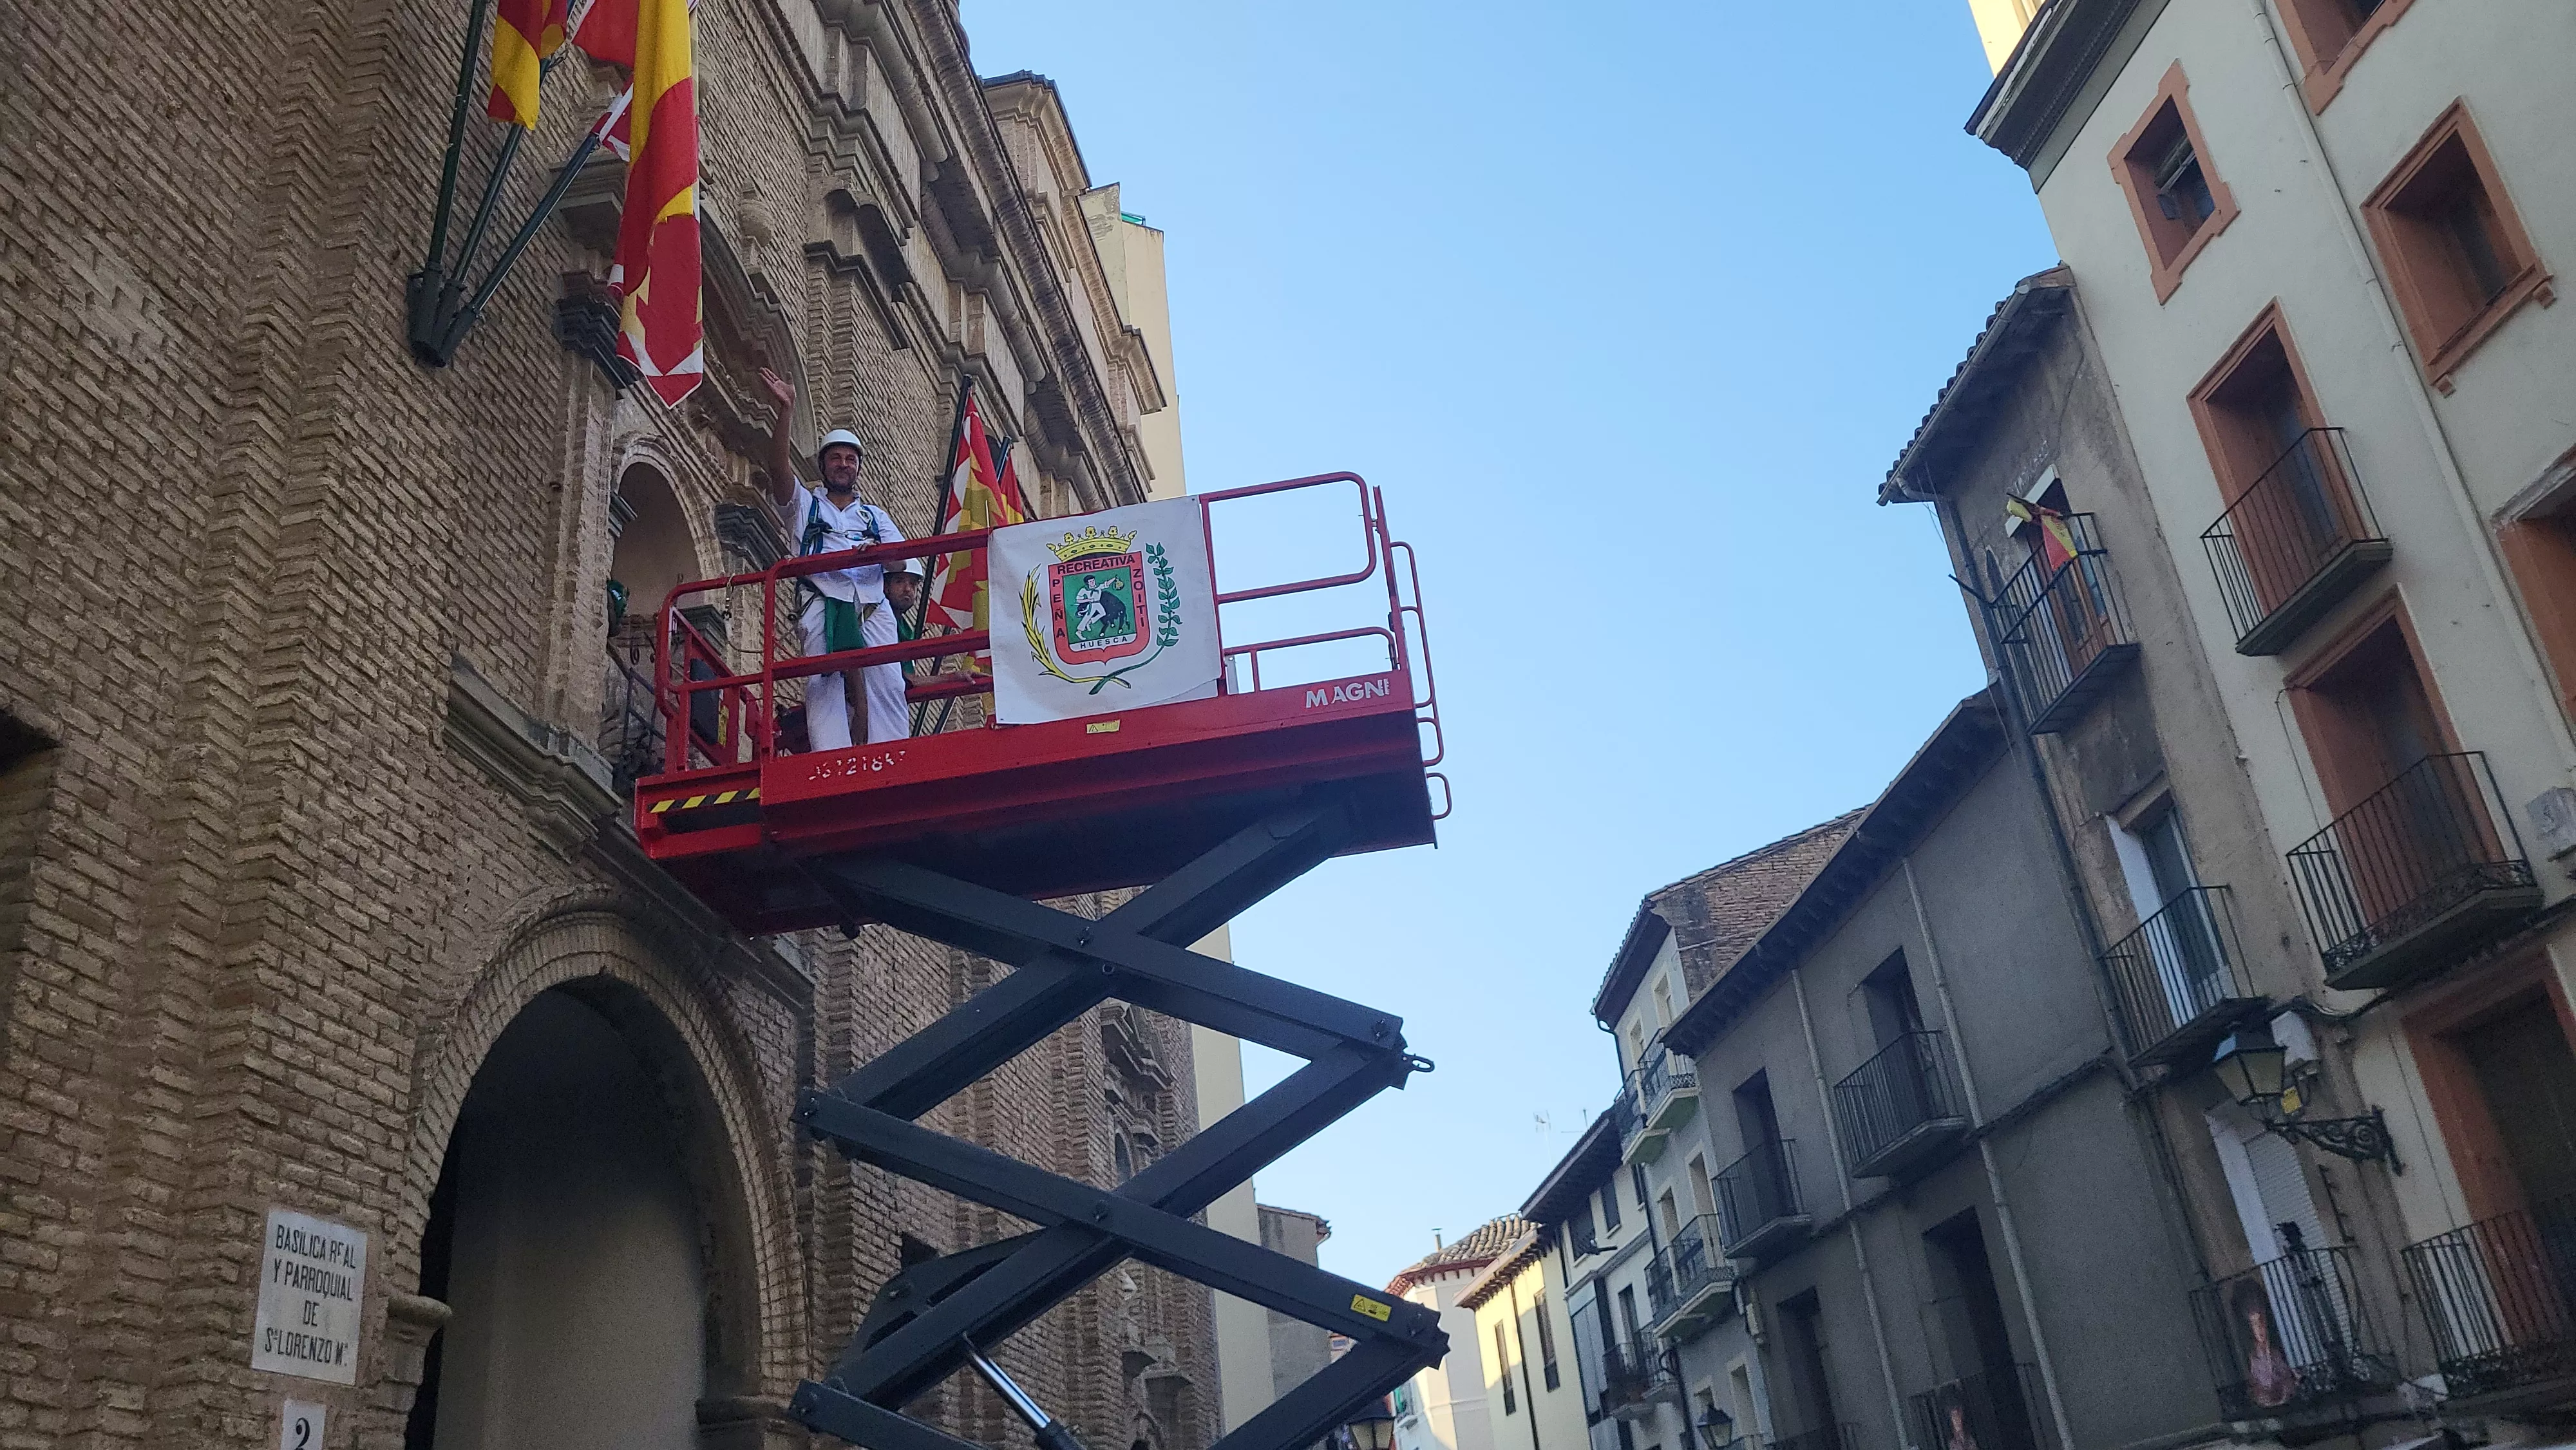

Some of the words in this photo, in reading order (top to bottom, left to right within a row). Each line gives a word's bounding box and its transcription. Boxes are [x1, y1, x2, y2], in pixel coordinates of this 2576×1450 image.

[1057, 554, 1135, 575] RECREATIVA
[1052, 579, 1066, 639] PEÑA
[1132, 568, 1146, 627] ZOITI
[1080, 636, 1128, 649] HUESCA
[1305, 678, 1390, 709] MAGNI
[274, 1257, 282, 1283] Y
[284, 1261, 353, 1301] PARROQUIAL
[303, 1300, 320, 1326] DE
[294, 1417, 310, 1450] 2
